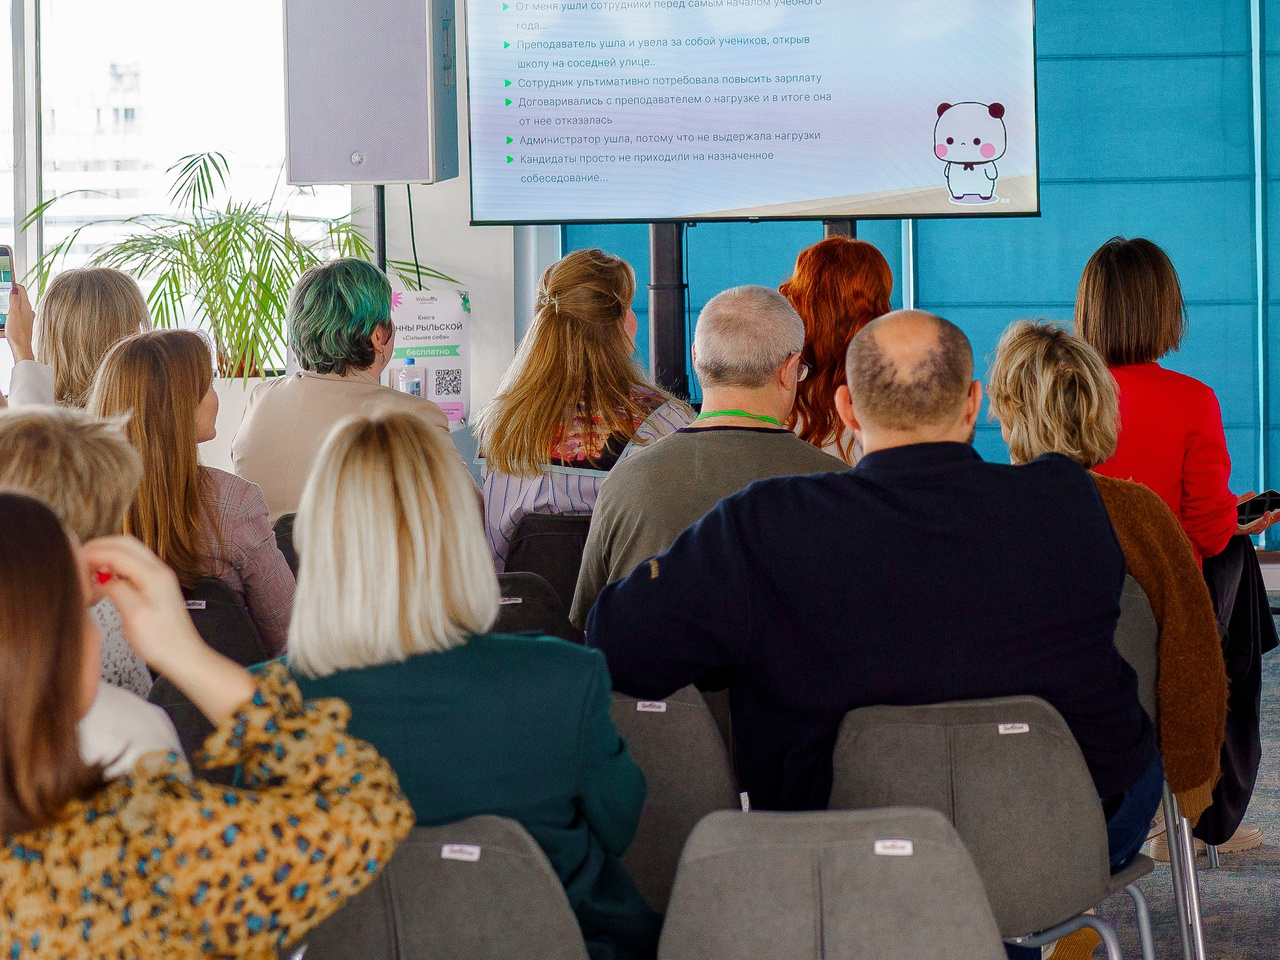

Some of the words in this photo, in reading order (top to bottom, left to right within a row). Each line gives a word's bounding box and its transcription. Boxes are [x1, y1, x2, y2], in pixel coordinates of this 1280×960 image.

[515, 1, 529, 11] От
[560, 2, 588, 12] ушли
[590, 1, 651, 11] сотрудники
[653, 0, 686, 9] перед
[687, 0, 724, 8] самым
[516, 39, 597, 50] Преподаватель
[599, 40, 626, 50] ушла
[637, 39, 668, 49] увела
[670, 38, 682, 46] за
[684, 36, 716, 46] собой
[718, 37, 770, 47] учеников,
[772, 36, 810, 45] открыв
[517, 60, 550, 70] школу
[552, 60, 565, 68] на
[566, 57, 617, 68] соседней
[517, 77, 574, 89] Сотрудник
[576, 78, 650, 87] ультимативно
[652, 75, 720, 85] потребовала
[721, 75, 772, 84] повысить
[774, 74, 822, 85] зарплату
[518, 96, 604, 108] Договаривались
[605, 97, 612, 105] с
[614, 96, 702, 106] преподавателем
[704, 95, 711, 103] о
[713, 95, 760, 105] нагрузке
[772, 94, 778, 102] в
[780, 94, 810, 102] итоге
[812, 93, 831, 101] она
[518, 118, 530, 126] от
[533, 117, 552, 125] нее
[554, 117, 613, 125] отказалась
[519, 135, 601, 146] Администратор
[603, 135, 633, 145] ушла,
[635, 135, 674, 144] потому
[676, 134, 695, 142] что
[697, 134, 710, 142] не
[712, 133, 772, 142] выдержала
[774, 132, 821, 142] нагрузки
[520, 154, 577, 165] Кандидаты
[579, 154, 616, 164] просто
[618, 154, 631, 162] не
[633, 153, 690, 163] приходили
[692, 153, 705, 161] на
[707, 152, 774, 160] назначенное
[395, 324, 415, 332] ННЫ
[416, 322, 463, 331] РЫЛЬСКОЙ
[406, 348, 450, 356] бесплатно
